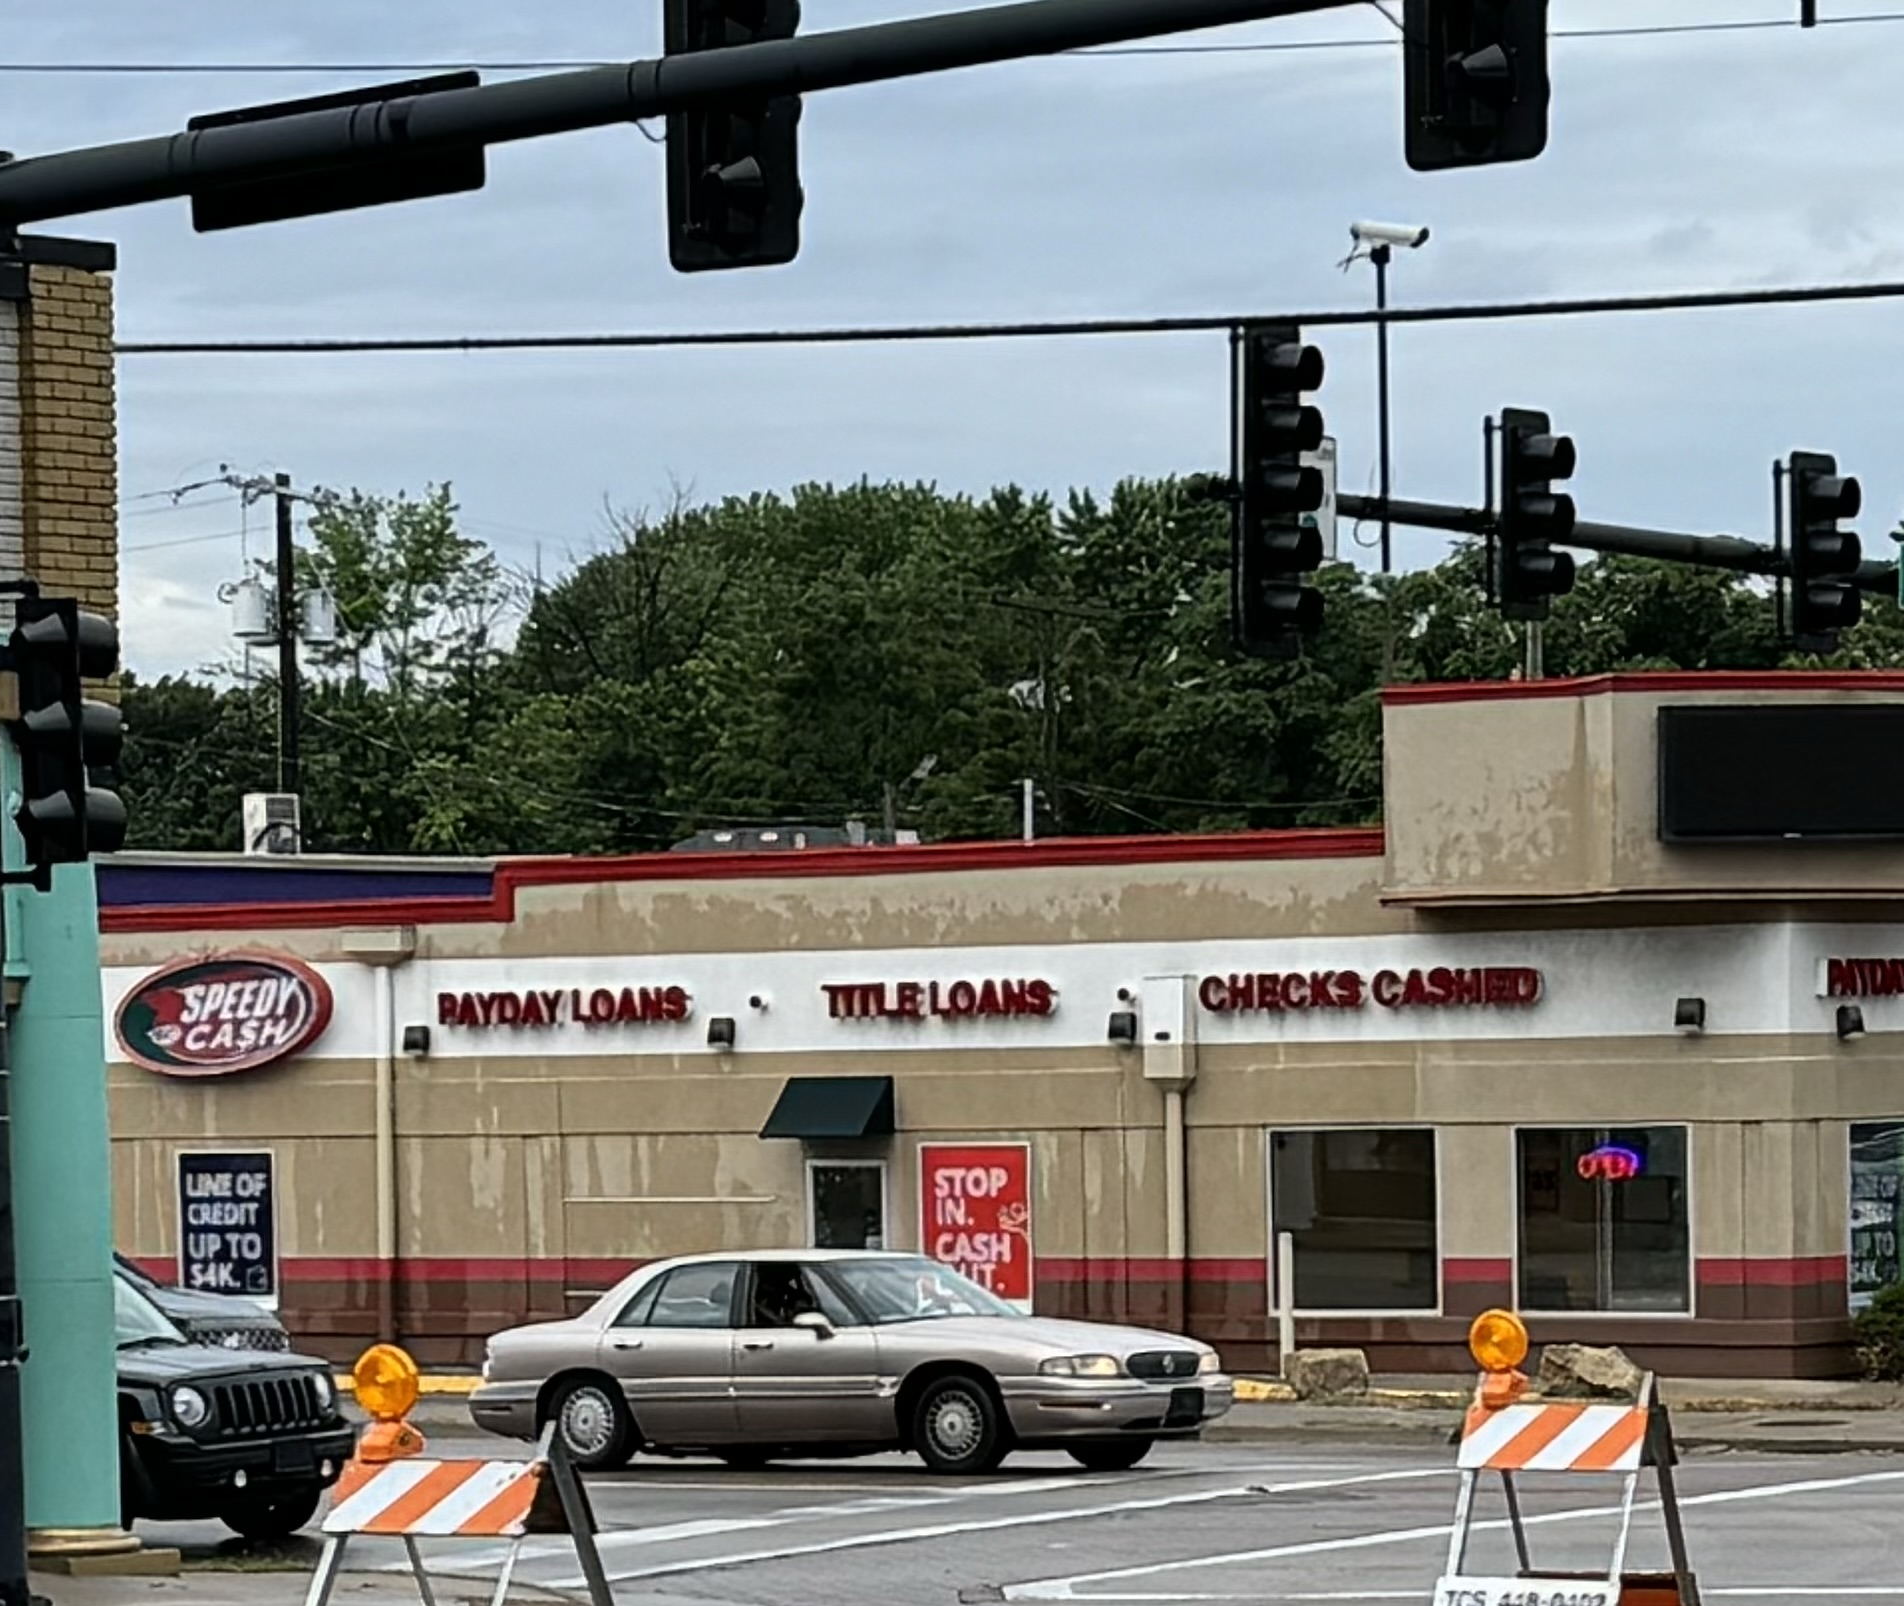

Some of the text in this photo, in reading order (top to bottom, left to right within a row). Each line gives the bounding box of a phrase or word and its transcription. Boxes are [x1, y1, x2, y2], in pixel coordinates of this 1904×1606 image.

[180, 976, 299, 1024] SPEEDY
[820, 979, 1055, 1018] TITLE LOANS
[1199, 967, 1543, 1012] CHECKS CASHED
[437, 986, 691, 1025] PAYDAY LOANS
[186, 1172, 267, 1197] LINE OF
[934, 1167, 1008, 1197] STOP
[188, 1203, 259, 1225] CREDIT
[936, 1197, 975, 1226] IN.
[189, 1232, 261, 1259] UP TO
[936, 1232, 1011, 1264] CASH
